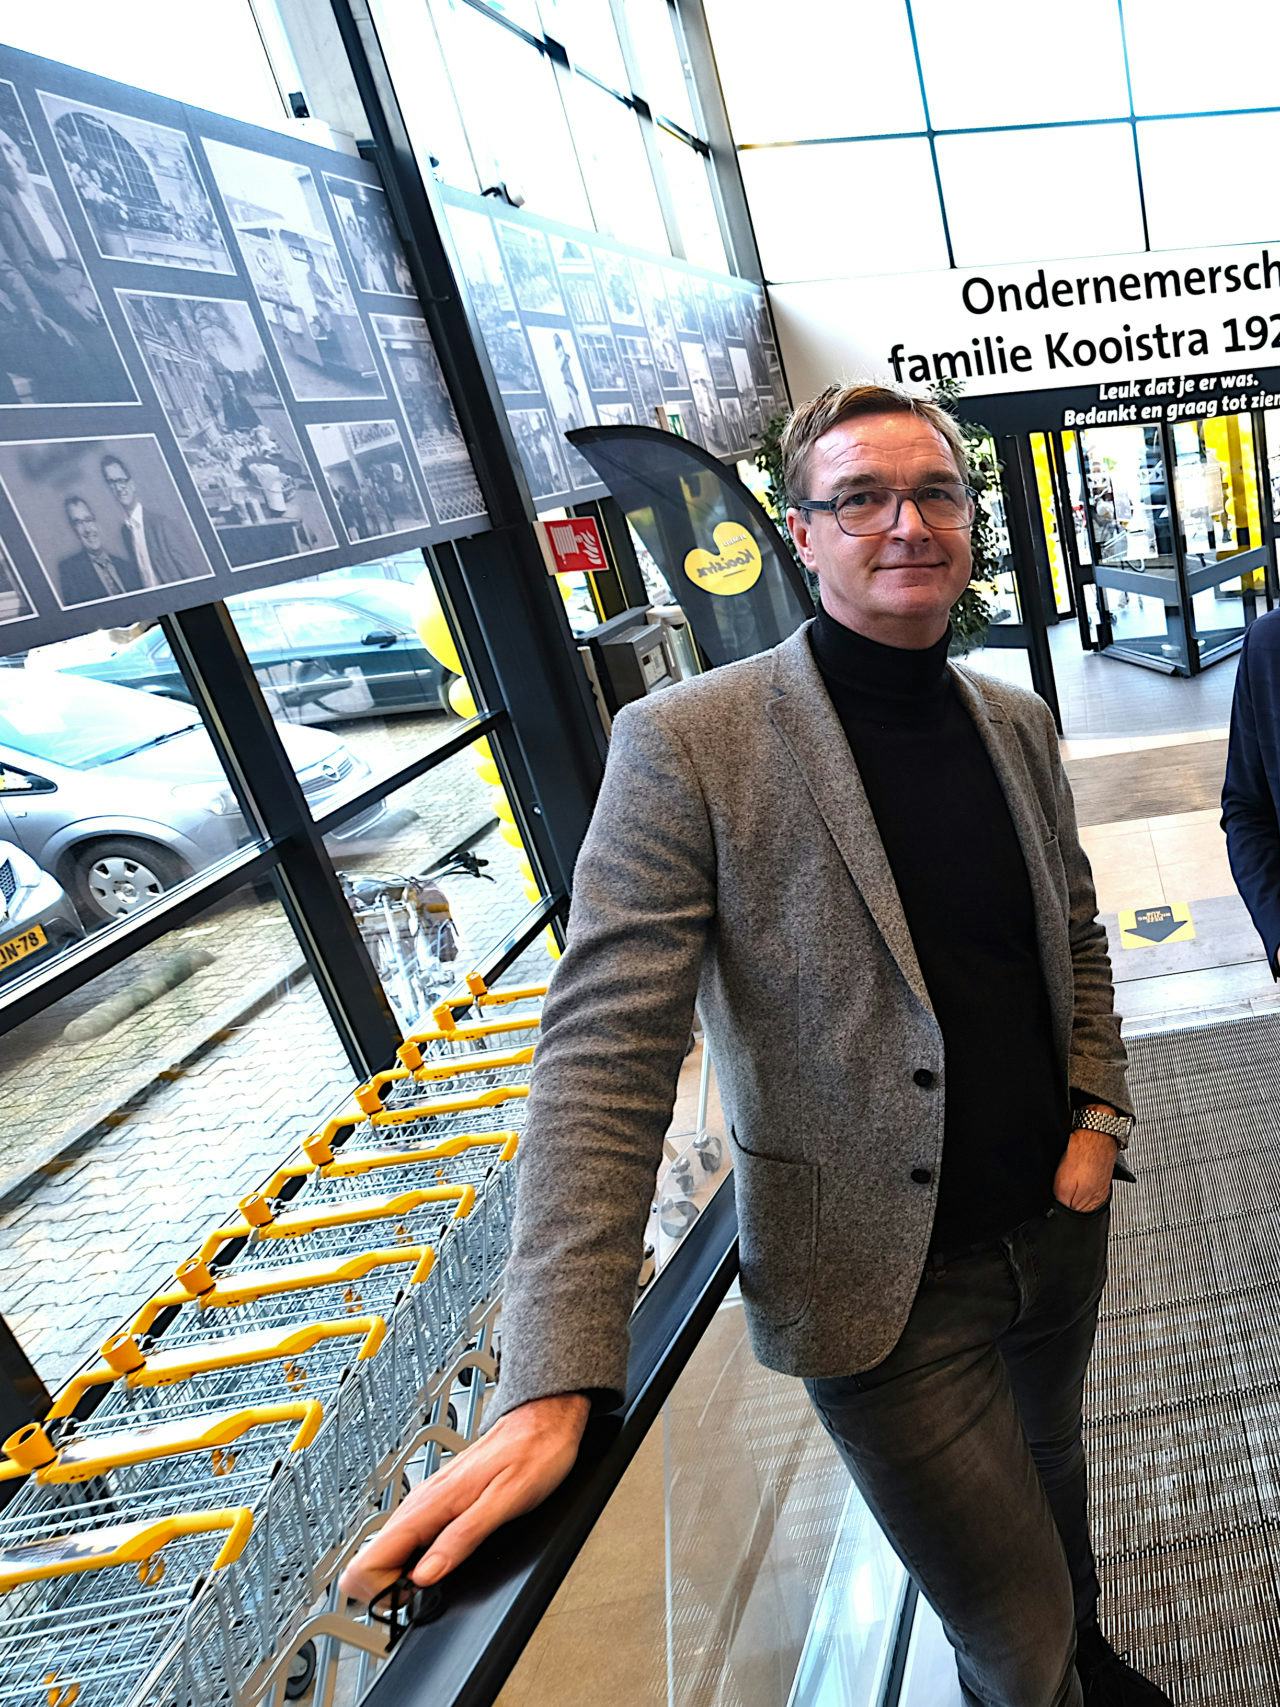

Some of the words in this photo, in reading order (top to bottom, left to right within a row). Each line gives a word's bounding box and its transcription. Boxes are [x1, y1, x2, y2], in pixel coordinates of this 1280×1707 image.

[887, 335, 1033, 384] familie
[1045, 323, 1209, 369] Kooistra
[1099, 379, 1141, 401] Leuk
[1144, 377, 1175, 396] dat
[1176, 375, 1195, 399] je
[1199, 377, 1217, 391] er
[1220, 373, 1259, 389] was.
[1064, 403, 1137, 427] Bedankt
[1141, 404, 1163, 419] en
[1166, 399, 1218, 422] graag
[1221, 393, 1247, 412] tot
